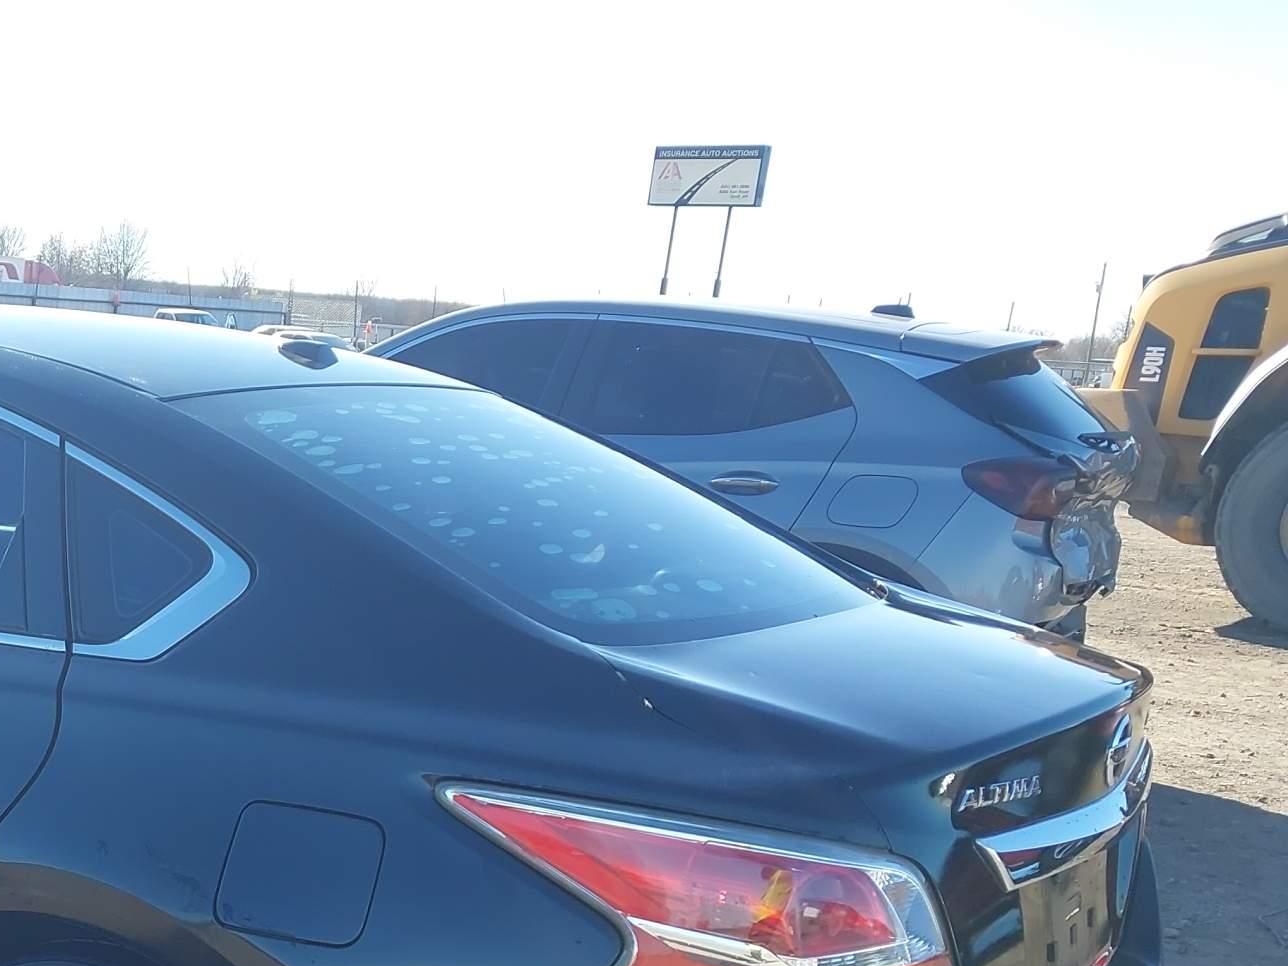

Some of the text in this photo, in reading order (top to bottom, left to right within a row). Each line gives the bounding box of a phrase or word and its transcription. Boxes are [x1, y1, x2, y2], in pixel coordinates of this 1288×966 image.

[659, 148, 759, 157] INSURANCE AUTO AUCTIONS
[1139, 346, 1167, 383] L90H
[957, 775, 1042, 812] ALTIMA
